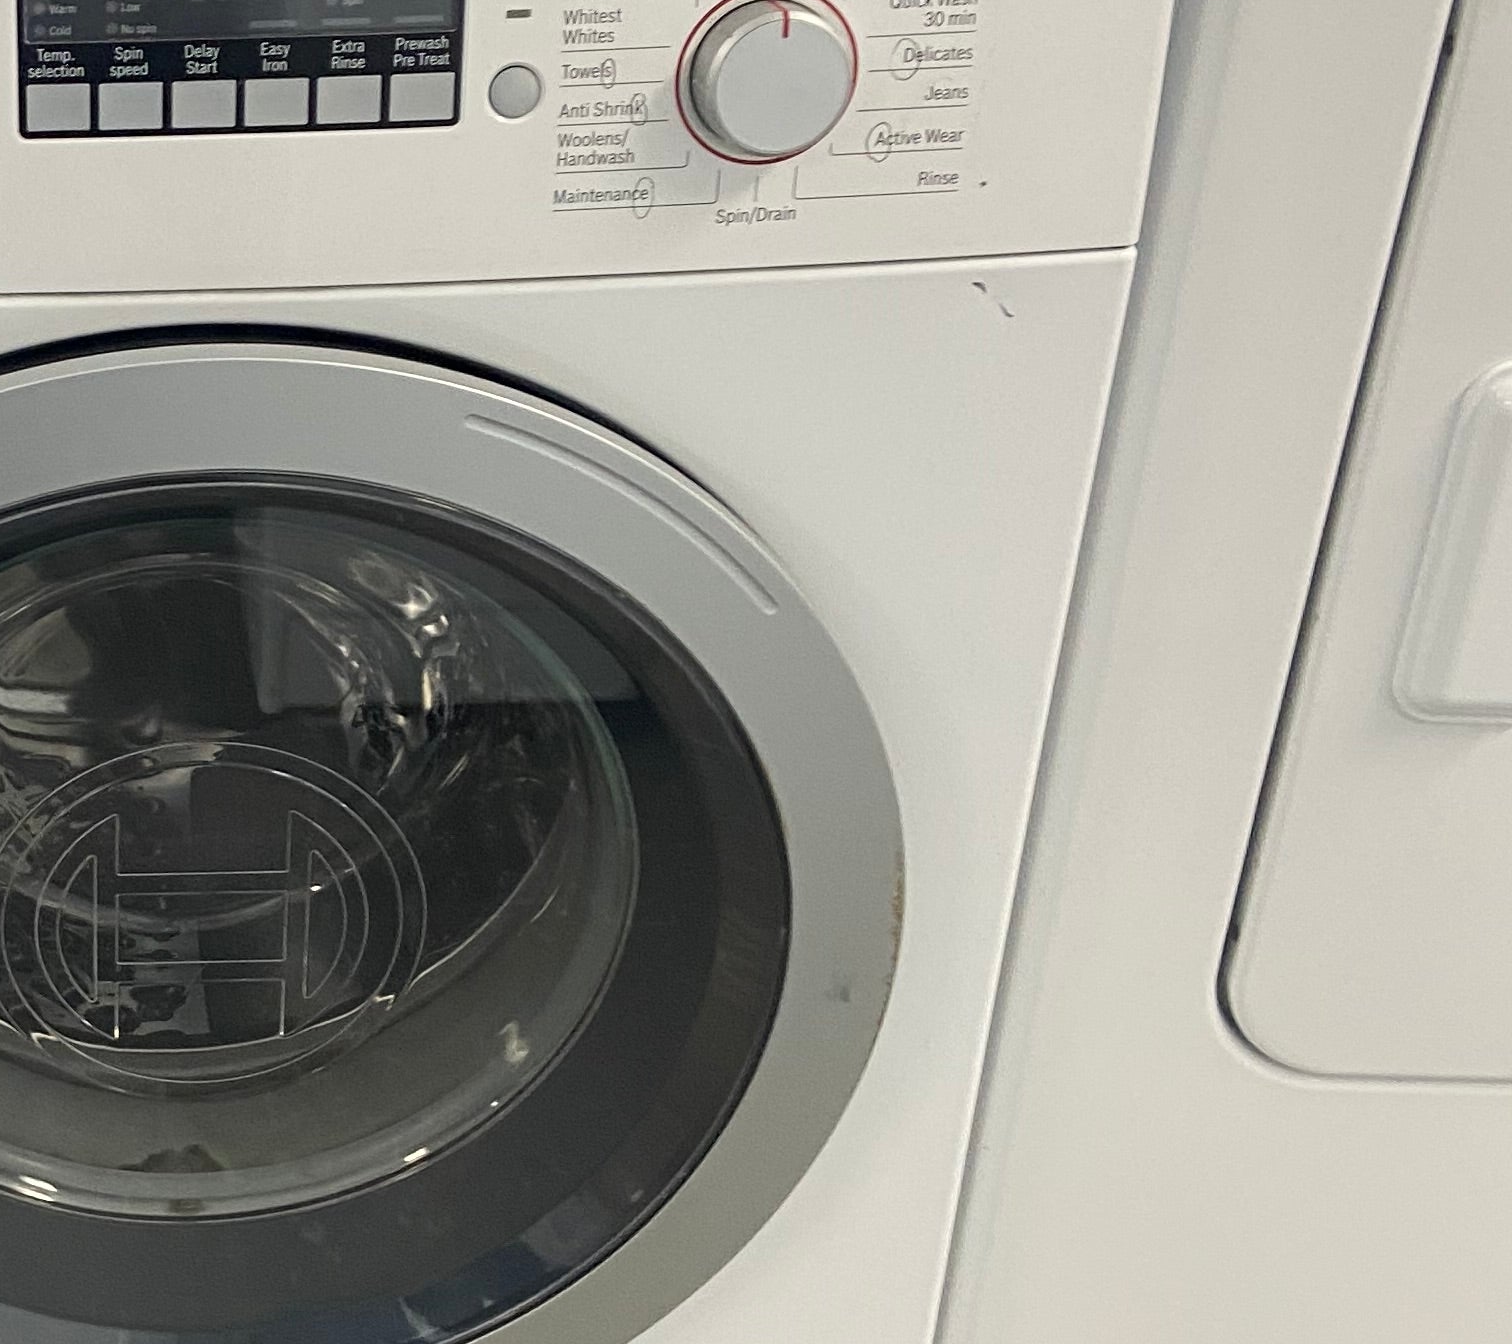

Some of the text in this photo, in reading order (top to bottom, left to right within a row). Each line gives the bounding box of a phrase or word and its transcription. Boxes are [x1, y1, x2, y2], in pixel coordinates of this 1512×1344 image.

[563, 8, 623, 26] Whitest
[923, 9, 977, 27] 30 min
[49, 25, 72, 36] Cold
[563, 28, 616, 45] Whites
[184, 43, 221, 61] Delay
[259, 41, 291, 59] Easy
[331, 39, 366, 54] Extra
[394, 35, 450, 52] Prewash
[36, 48, 76, 64] Temp.
[114, 46, 144, 63] Spin
[330, 55, 366, 70] Rinse
[393, 52, 451, 68] Pre Treat
[903, 46, 974, 64] Delicates
[27, 63, 85, 79] selection
[109, 62, 149, 78] speed
[185, 60, 219, 75] Start
[262, 58, 289, 72] Iron
[561, 64, 613, 80] Towels
[922, 86, 969, 101] Jeans
[559, 99, 646, 119] Anti Shrink
[557, 128, 631, 148] Woolens/
[873, 128, 966, 146] Active Wear
[556, 148, 635, 167] Handwash
[917, 170, 960, 187] Rinse
[553, 188, 650, 205] Maintenance
[714, 206, 797, 227] Spin/Drain
